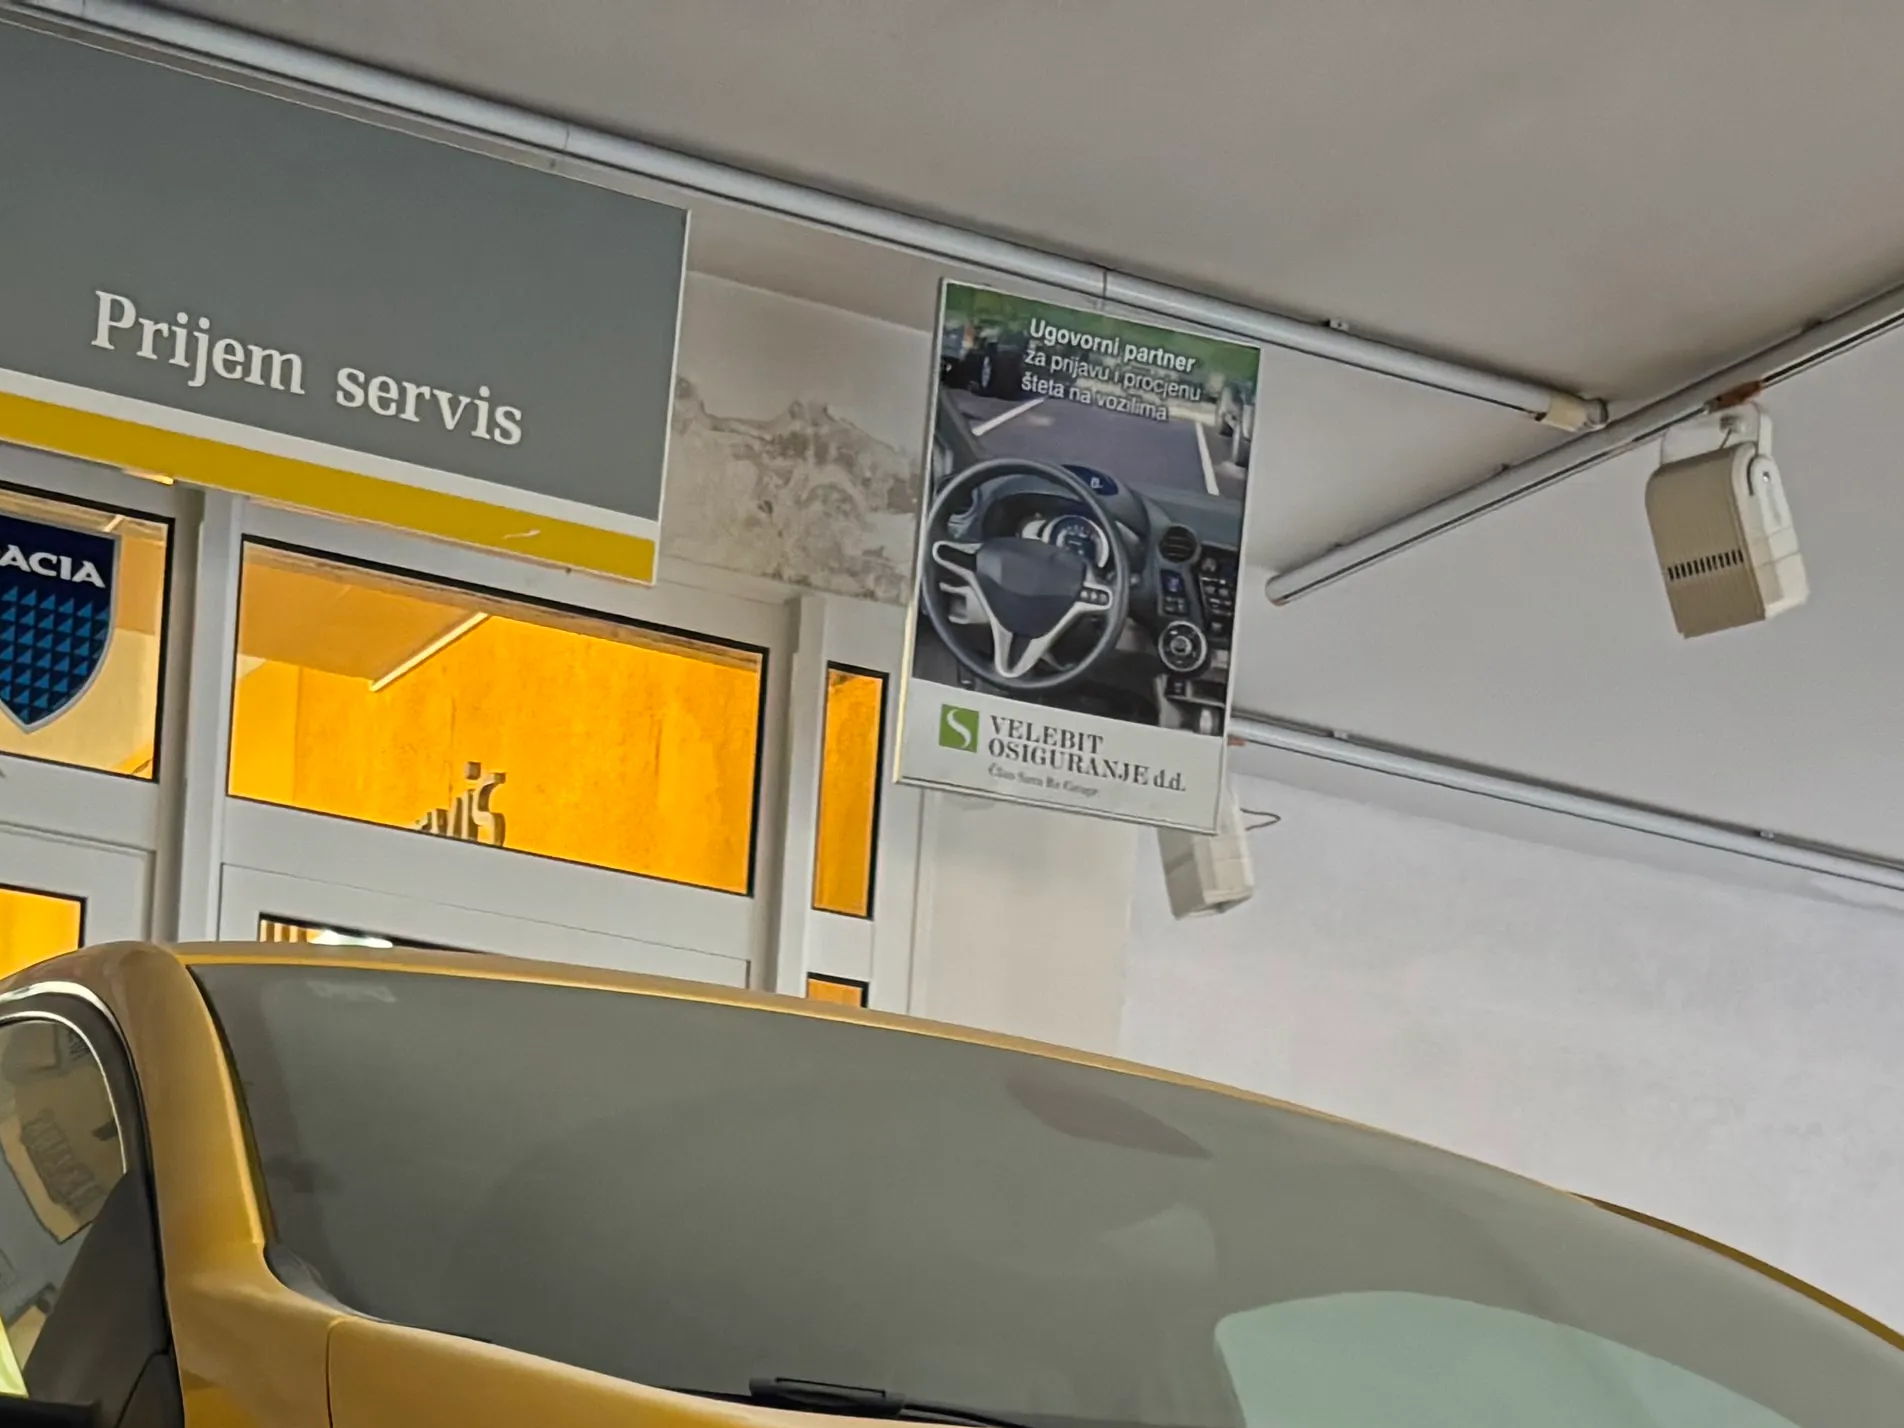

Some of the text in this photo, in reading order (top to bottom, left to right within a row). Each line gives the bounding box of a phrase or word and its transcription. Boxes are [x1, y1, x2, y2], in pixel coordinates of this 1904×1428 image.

[91, 290, 523, 446] Prijem servis
[1030, 318, 1196, 373] Ugovorni partner
[1021, 371, 1168, 421] šteta na vozilima
[1024, 349, 1046, 366] za
[1050, 354, 1109, 380] prijavu
[1123, 372, 1201, 401] procjenu
[990, 714, 1104, 754] VELEBIT
[988, 738, 1149, 786] OSIGURANJE
[1153, 769, 1186, 792] d.d.
